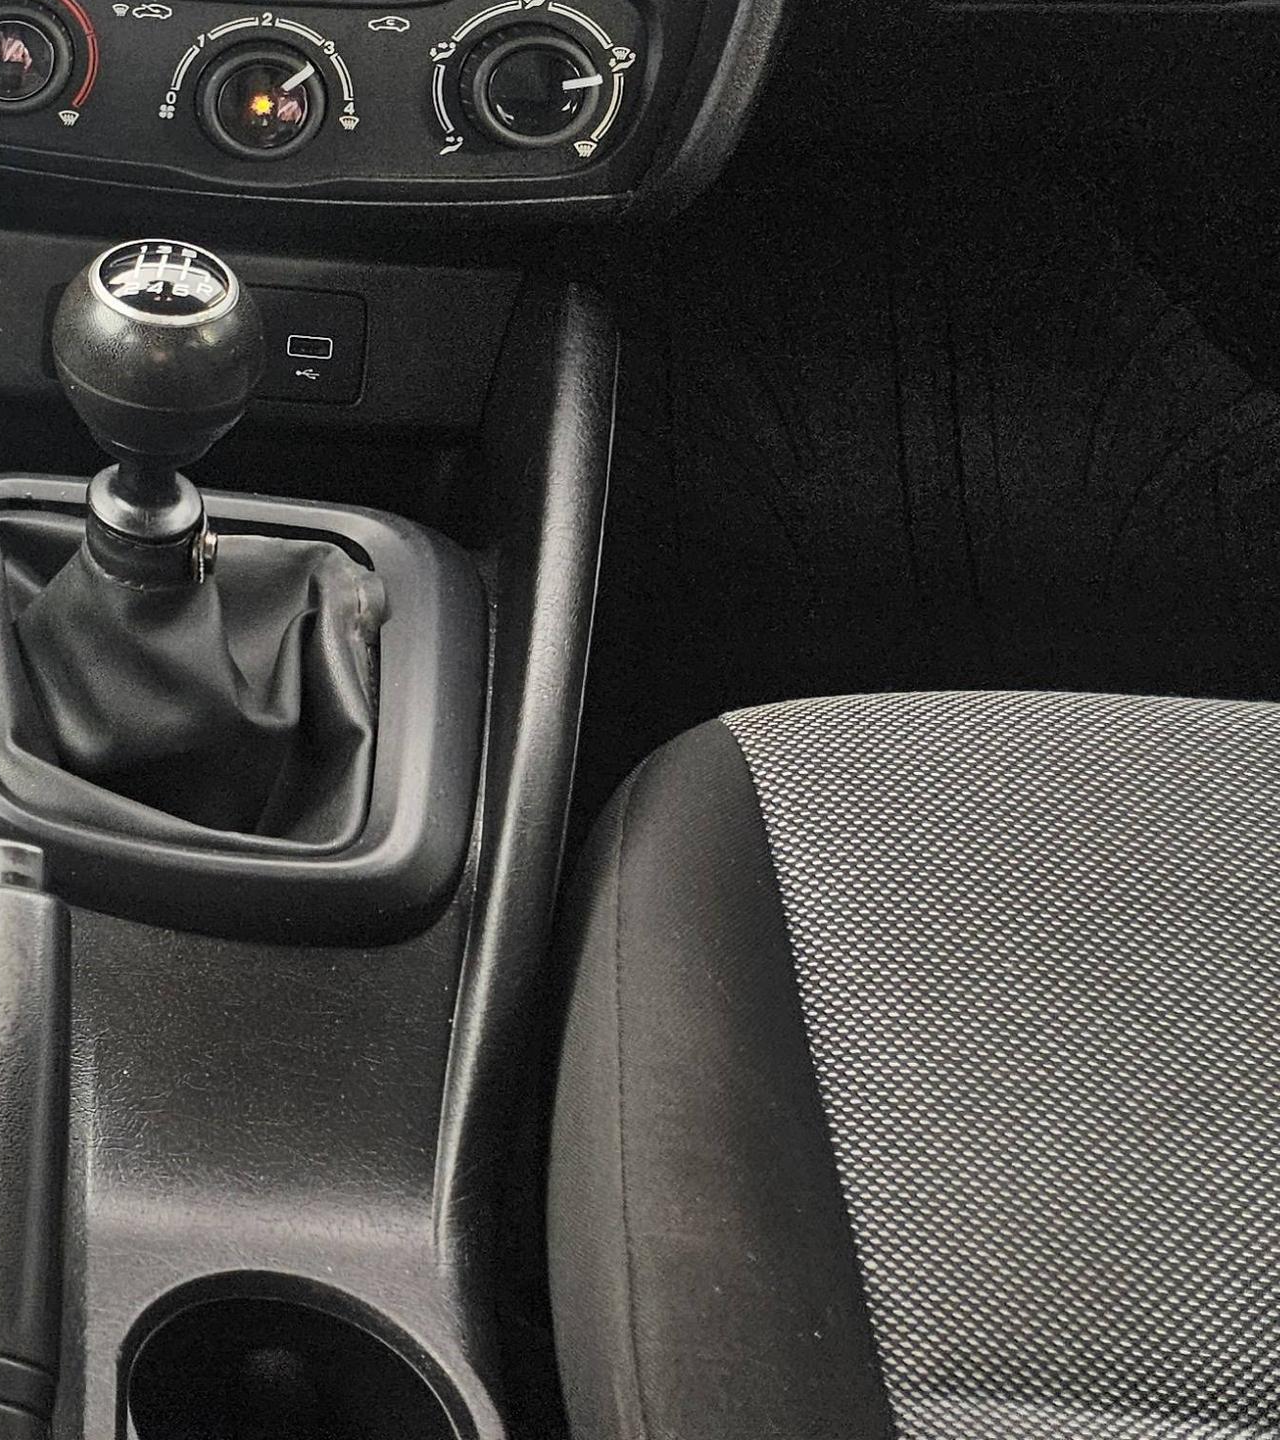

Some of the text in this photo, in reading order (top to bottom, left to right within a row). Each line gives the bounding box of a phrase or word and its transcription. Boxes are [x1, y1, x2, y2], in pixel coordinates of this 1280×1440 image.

[261, 12, 273, 26] 2
[197, 34, 206, 48] 1
[323, 40, 336, 54] 3
[165, 91, 177, 105] 0
[343, 101, 355, 115] 4
[146, 281, 164, 294] 4
[172, 284, 190, 297] 6
